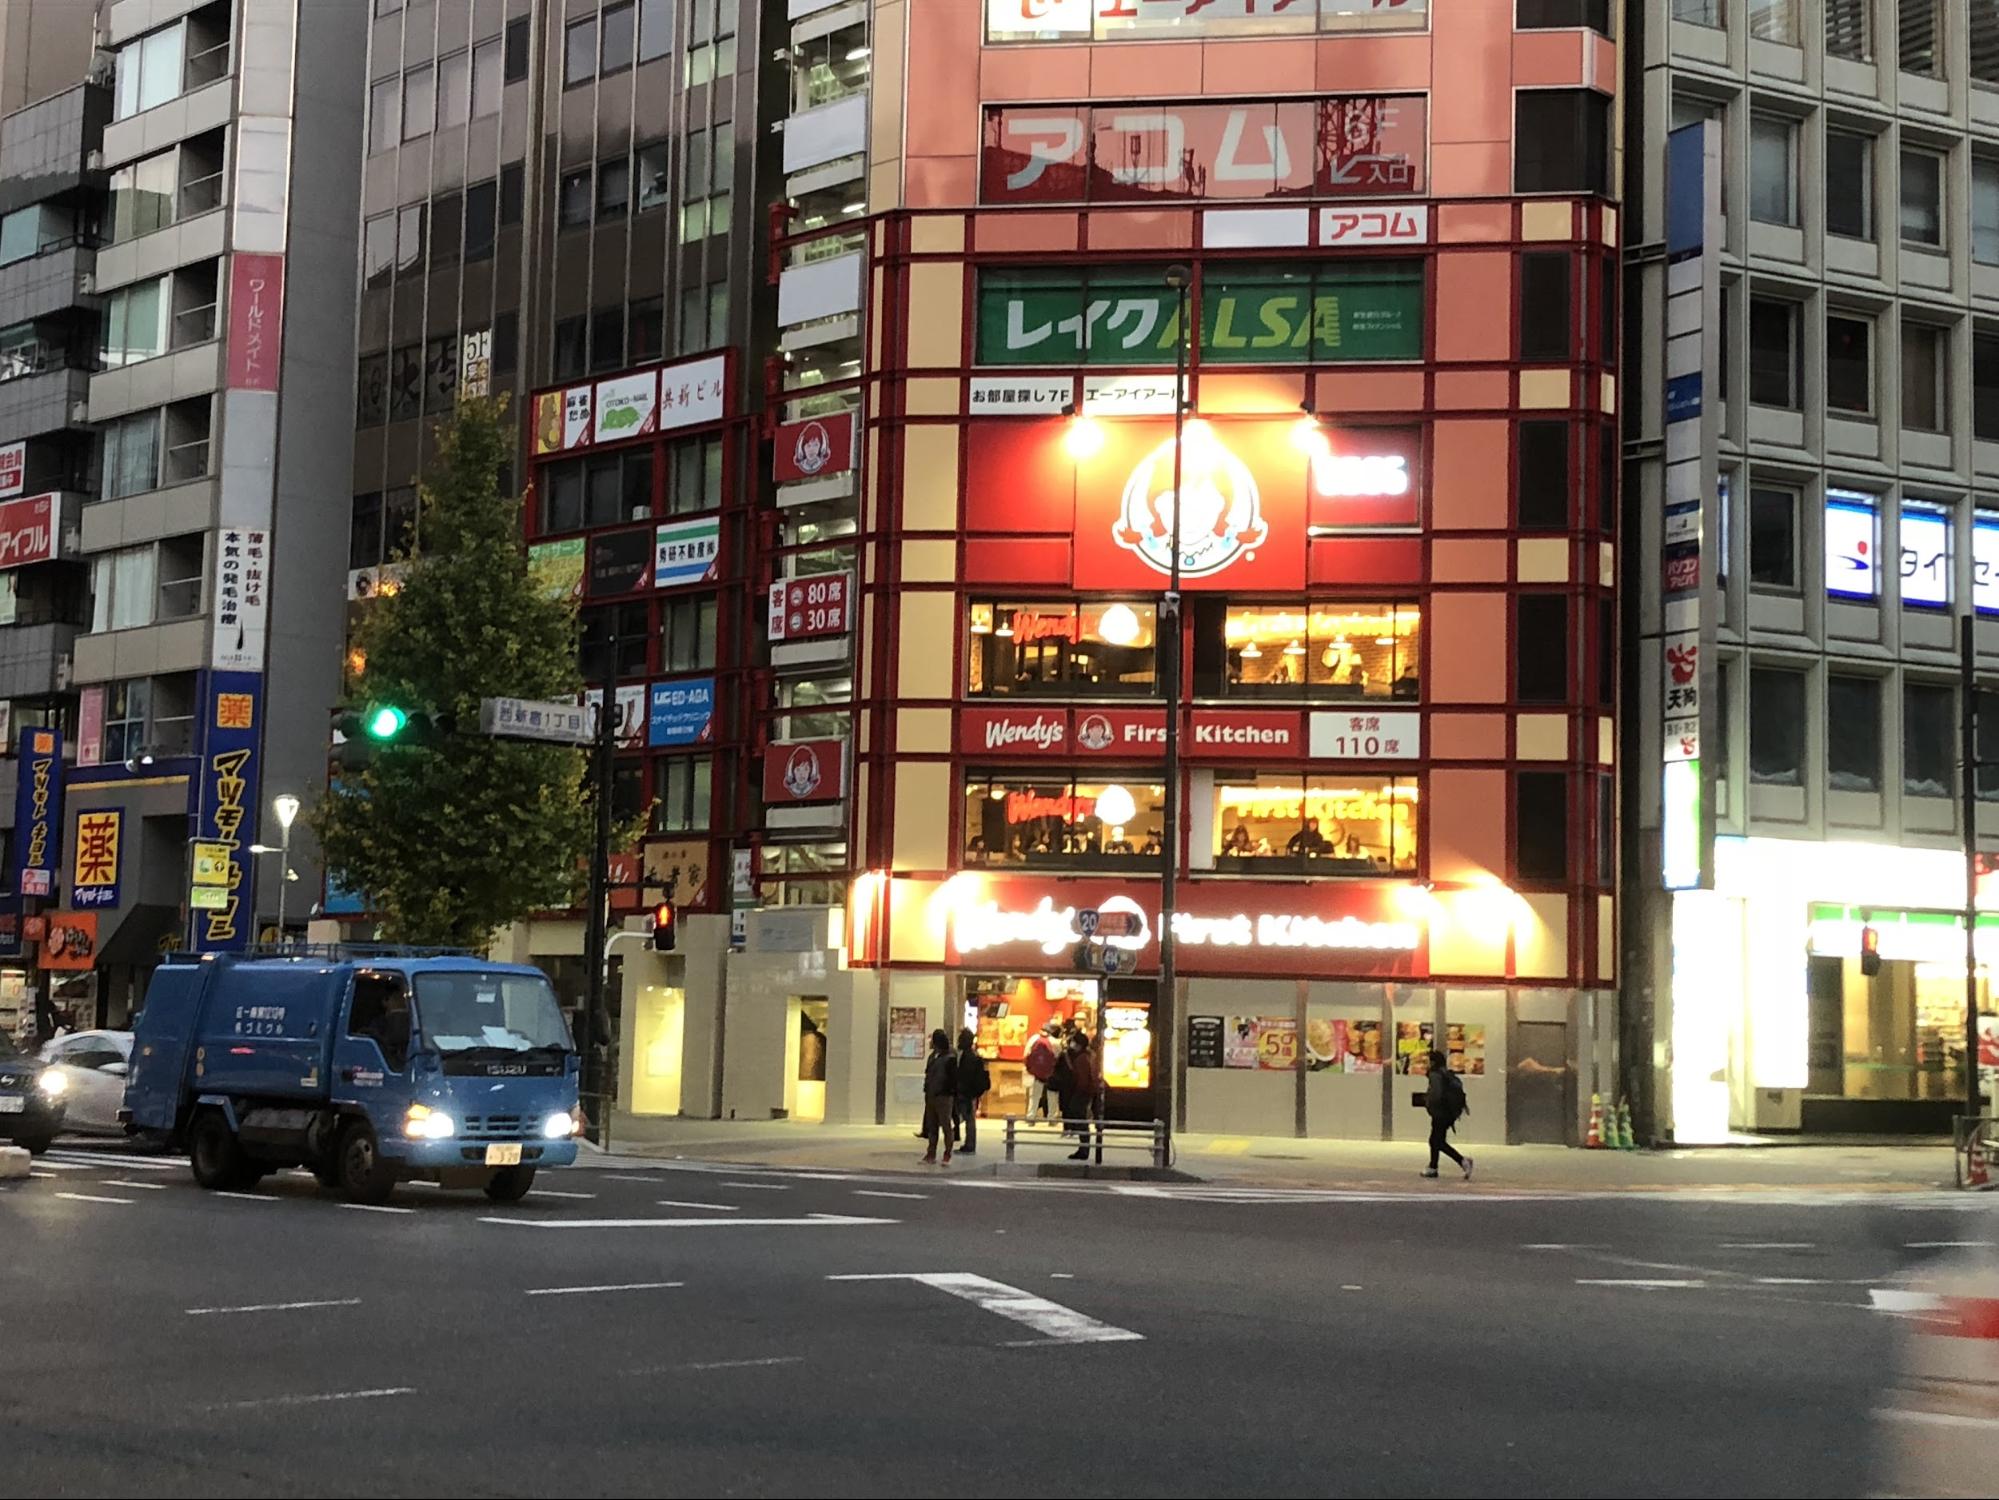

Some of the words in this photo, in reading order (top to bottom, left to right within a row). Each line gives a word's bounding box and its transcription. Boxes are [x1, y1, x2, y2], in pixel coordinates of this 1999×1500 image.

[1007, 109, 1292, 190] アコム
[1367, 163, 1409, 184] 入口
[1330, 211, 1418, 240] アコム
[247, 278, 266, 373] ワールドメイト
[971, 387, 1070, 403] お部屋探し7F
[220, 531, 241, 625] 本気の発毛治療
[807, 581, 842, 605] 80席
[770, 588, 784, 634] 客席
[807, 607, 841, 631] 30席
[220, 696, 250, 727] 薬
[1348, 716, 1380, 732] 客席
[985, 715, 1064, 749] Wendy's
[1123, 724, 1179, 742] Firs
[1195, 725, 1289, 744] Kitchen
[1335, 736, 1400, 756] 110席
[80, 815, 117, 883] 薬
[1082, 913, 1097, 931] 20
